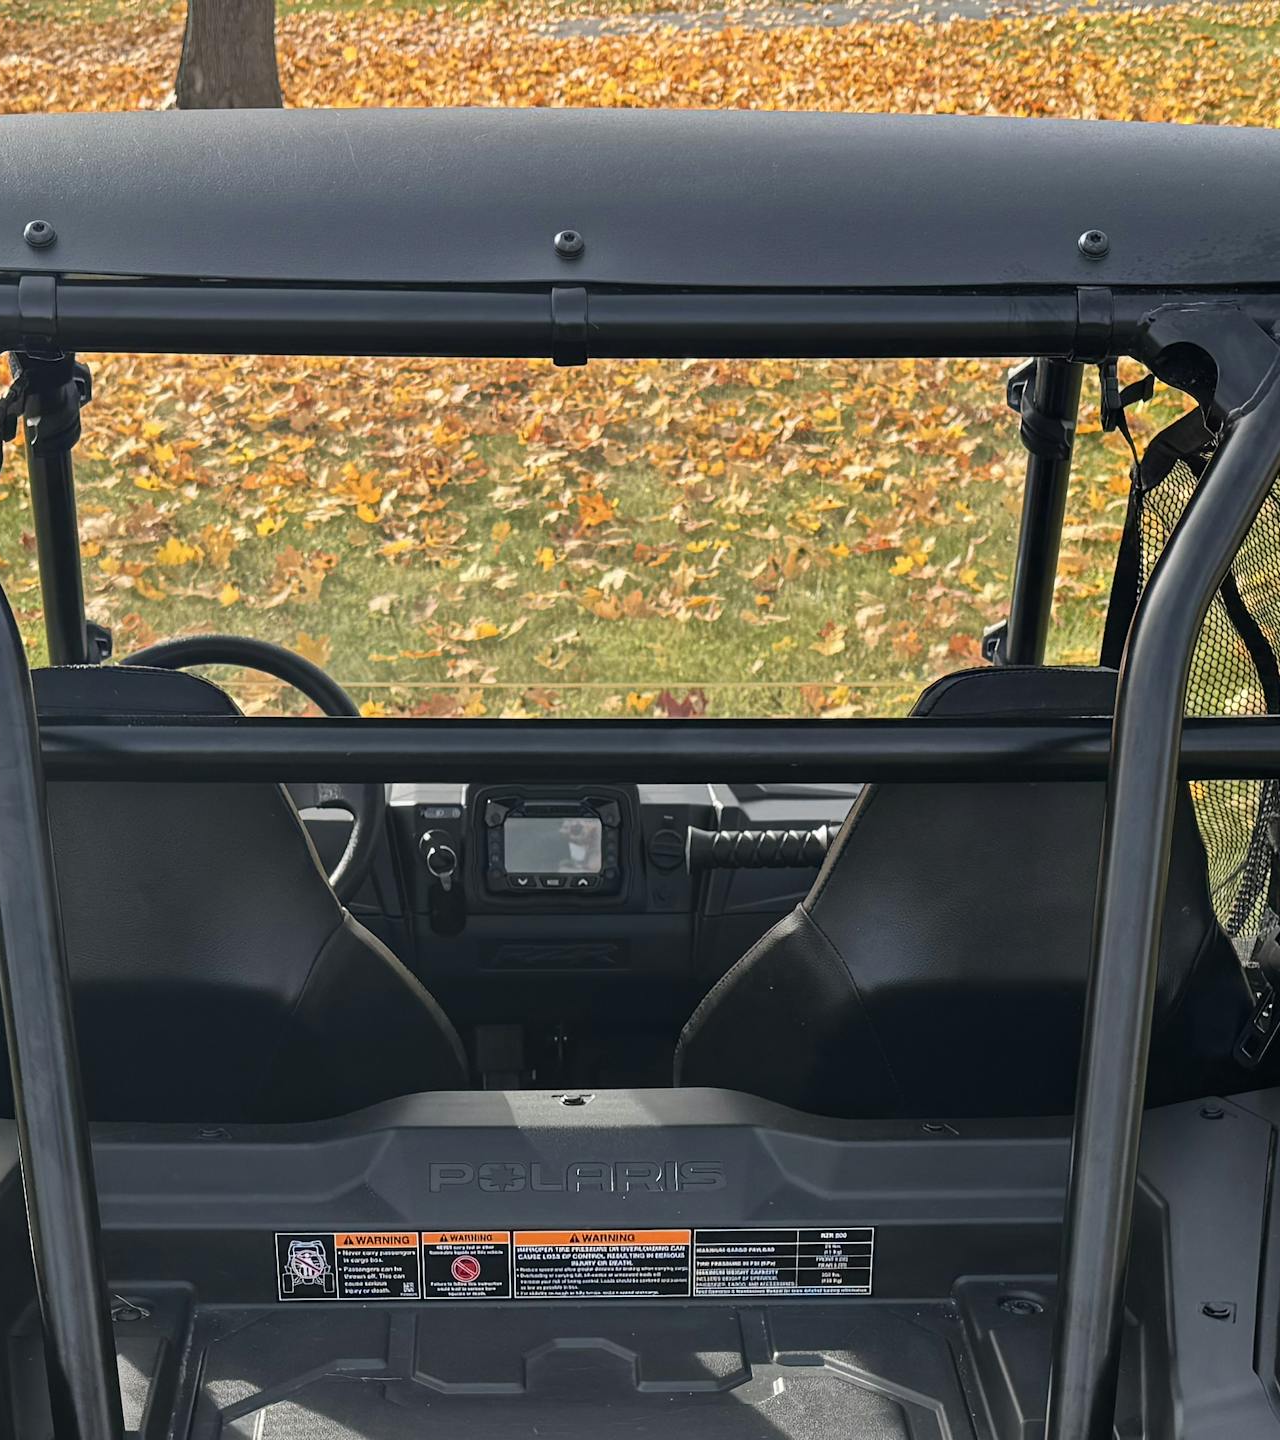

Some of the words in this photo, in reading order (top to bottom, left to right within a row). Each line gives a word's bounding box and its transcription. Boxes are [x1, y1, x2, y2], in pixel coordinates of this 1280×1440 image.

[429, 1161, 726, 1193] POLARIS
[356, 1236, 410, 1245] WARNING
[582, 1234, 635, 1242] WARNING
